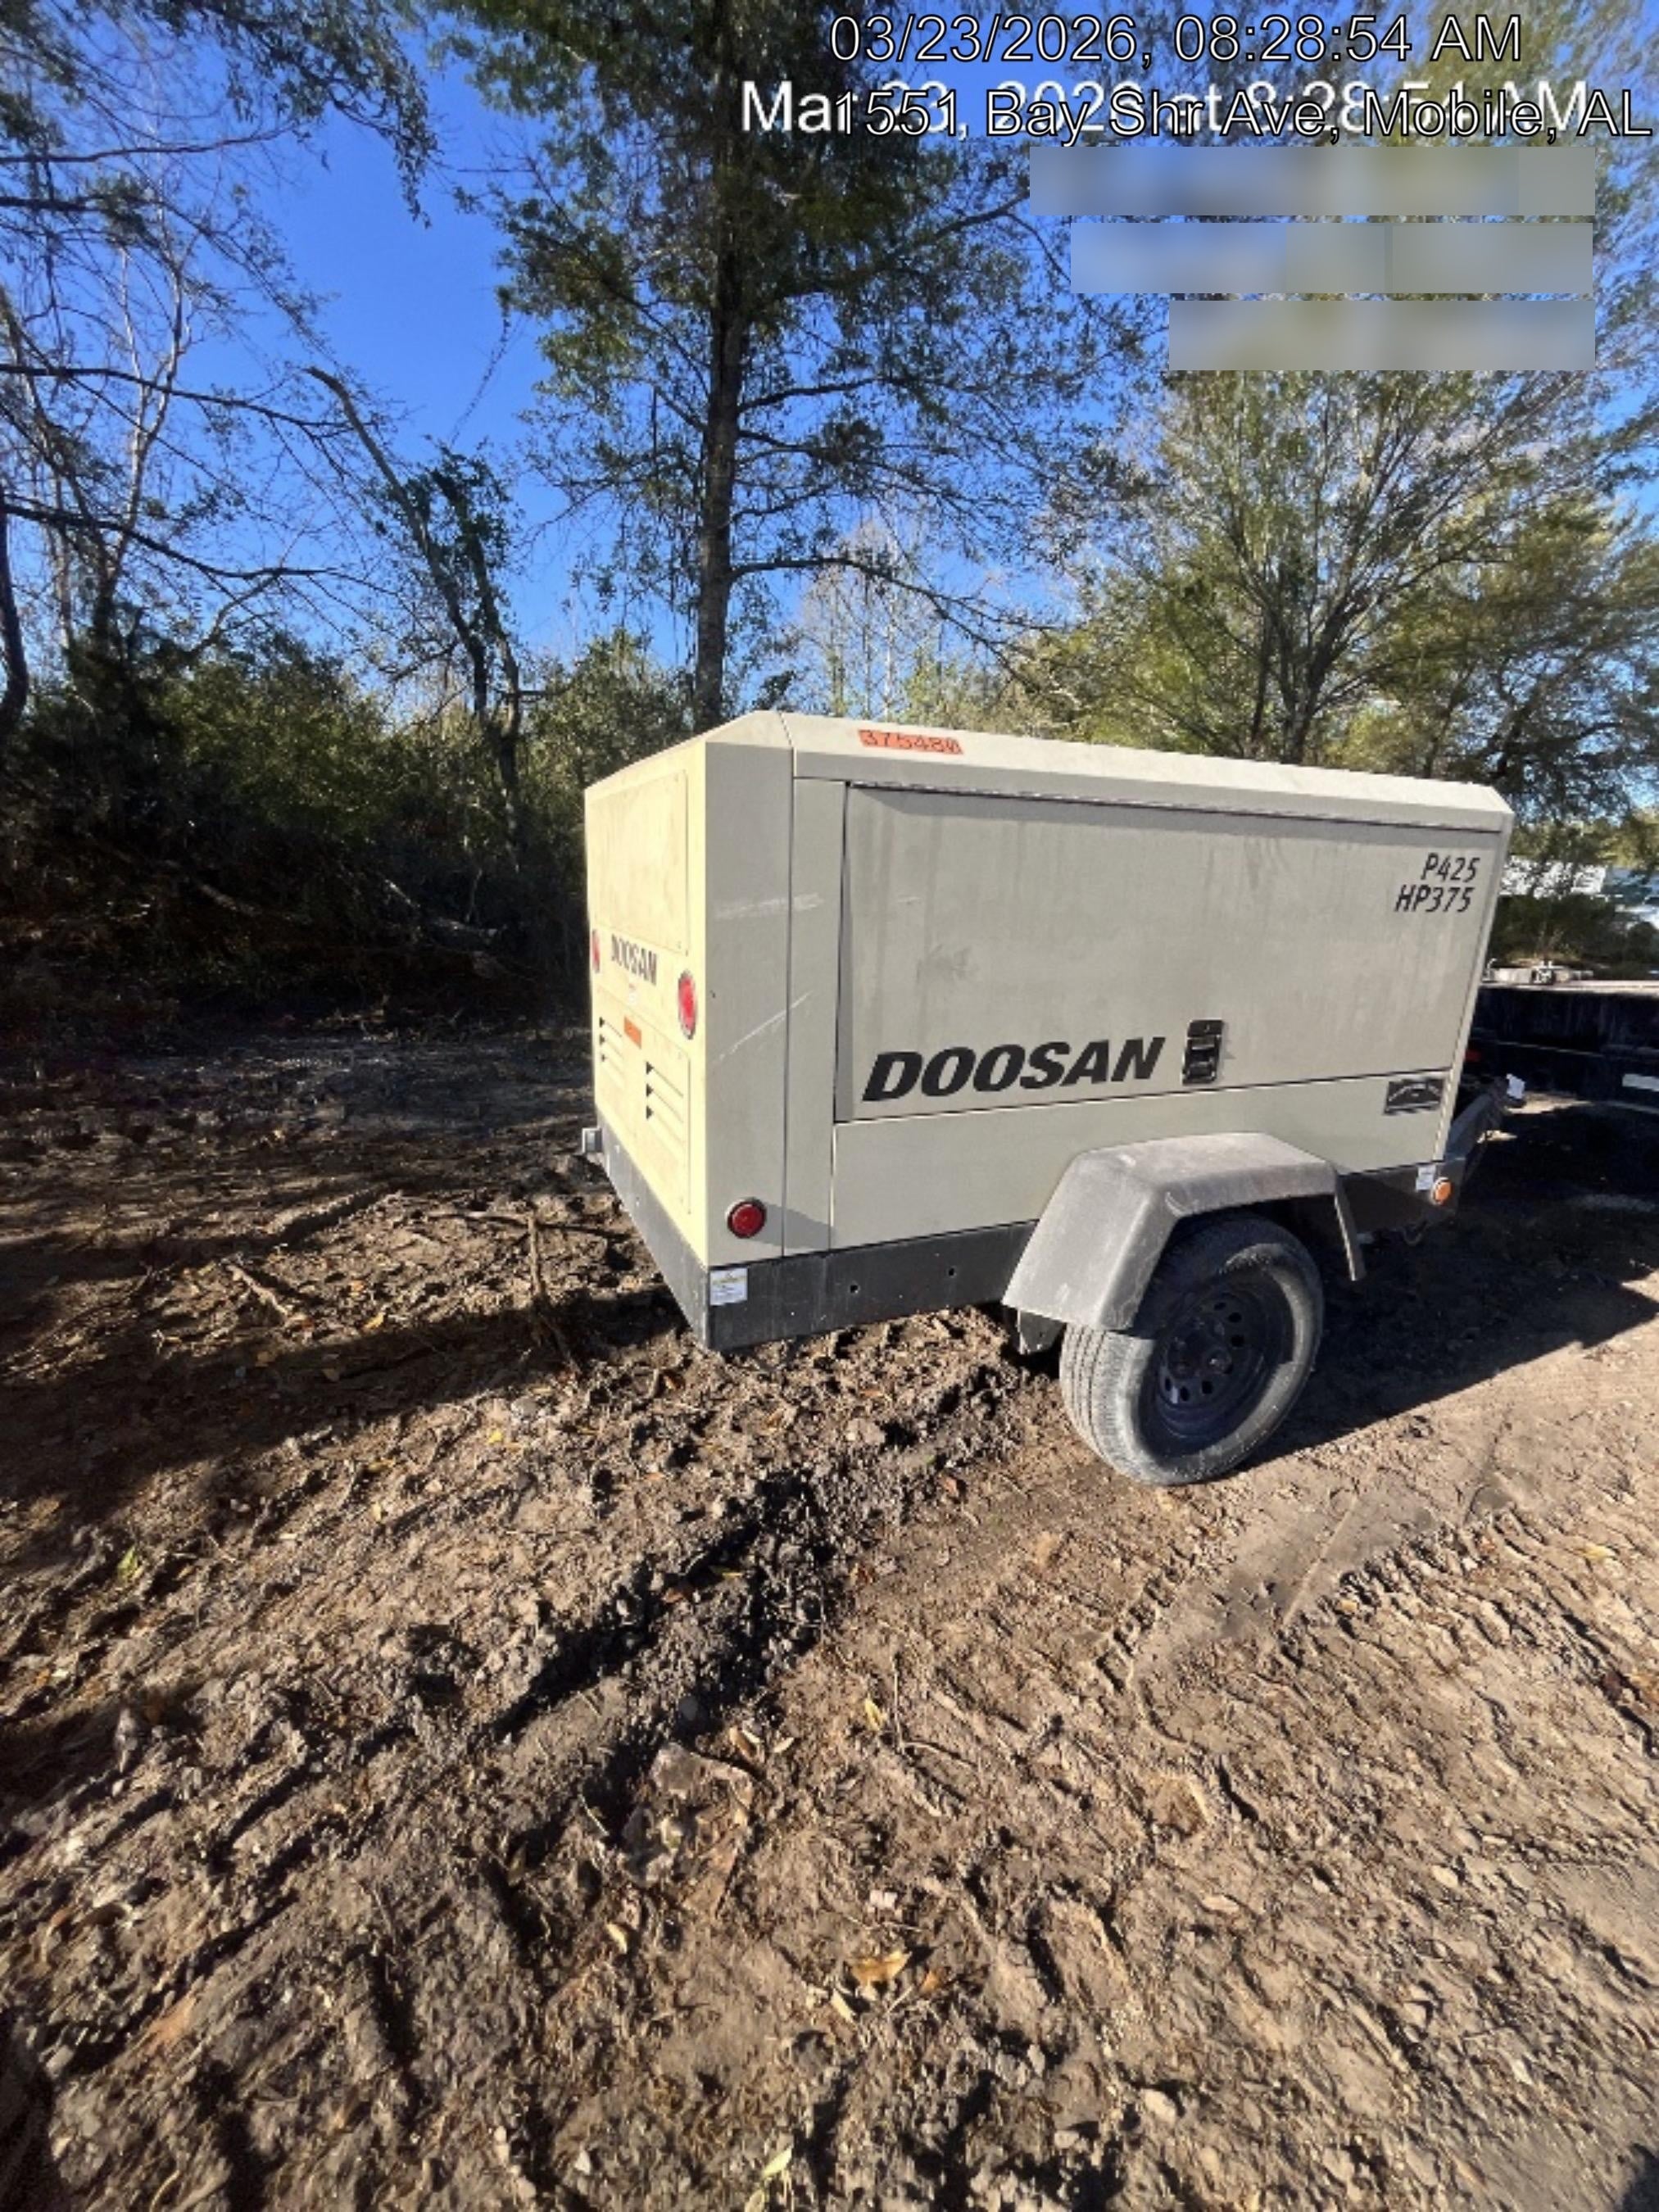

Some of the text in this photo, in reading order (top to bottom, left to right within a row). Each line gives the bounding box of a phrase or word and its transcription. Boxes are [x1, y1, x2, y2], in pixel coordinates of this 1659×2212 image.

[1420, 853, 1480, 883] P425
[1394, 884, 1475, 913] HP375
[611, 933, 657, 986] DOOSAN
[862, 1036, 1166, 1101] DOOSAN
